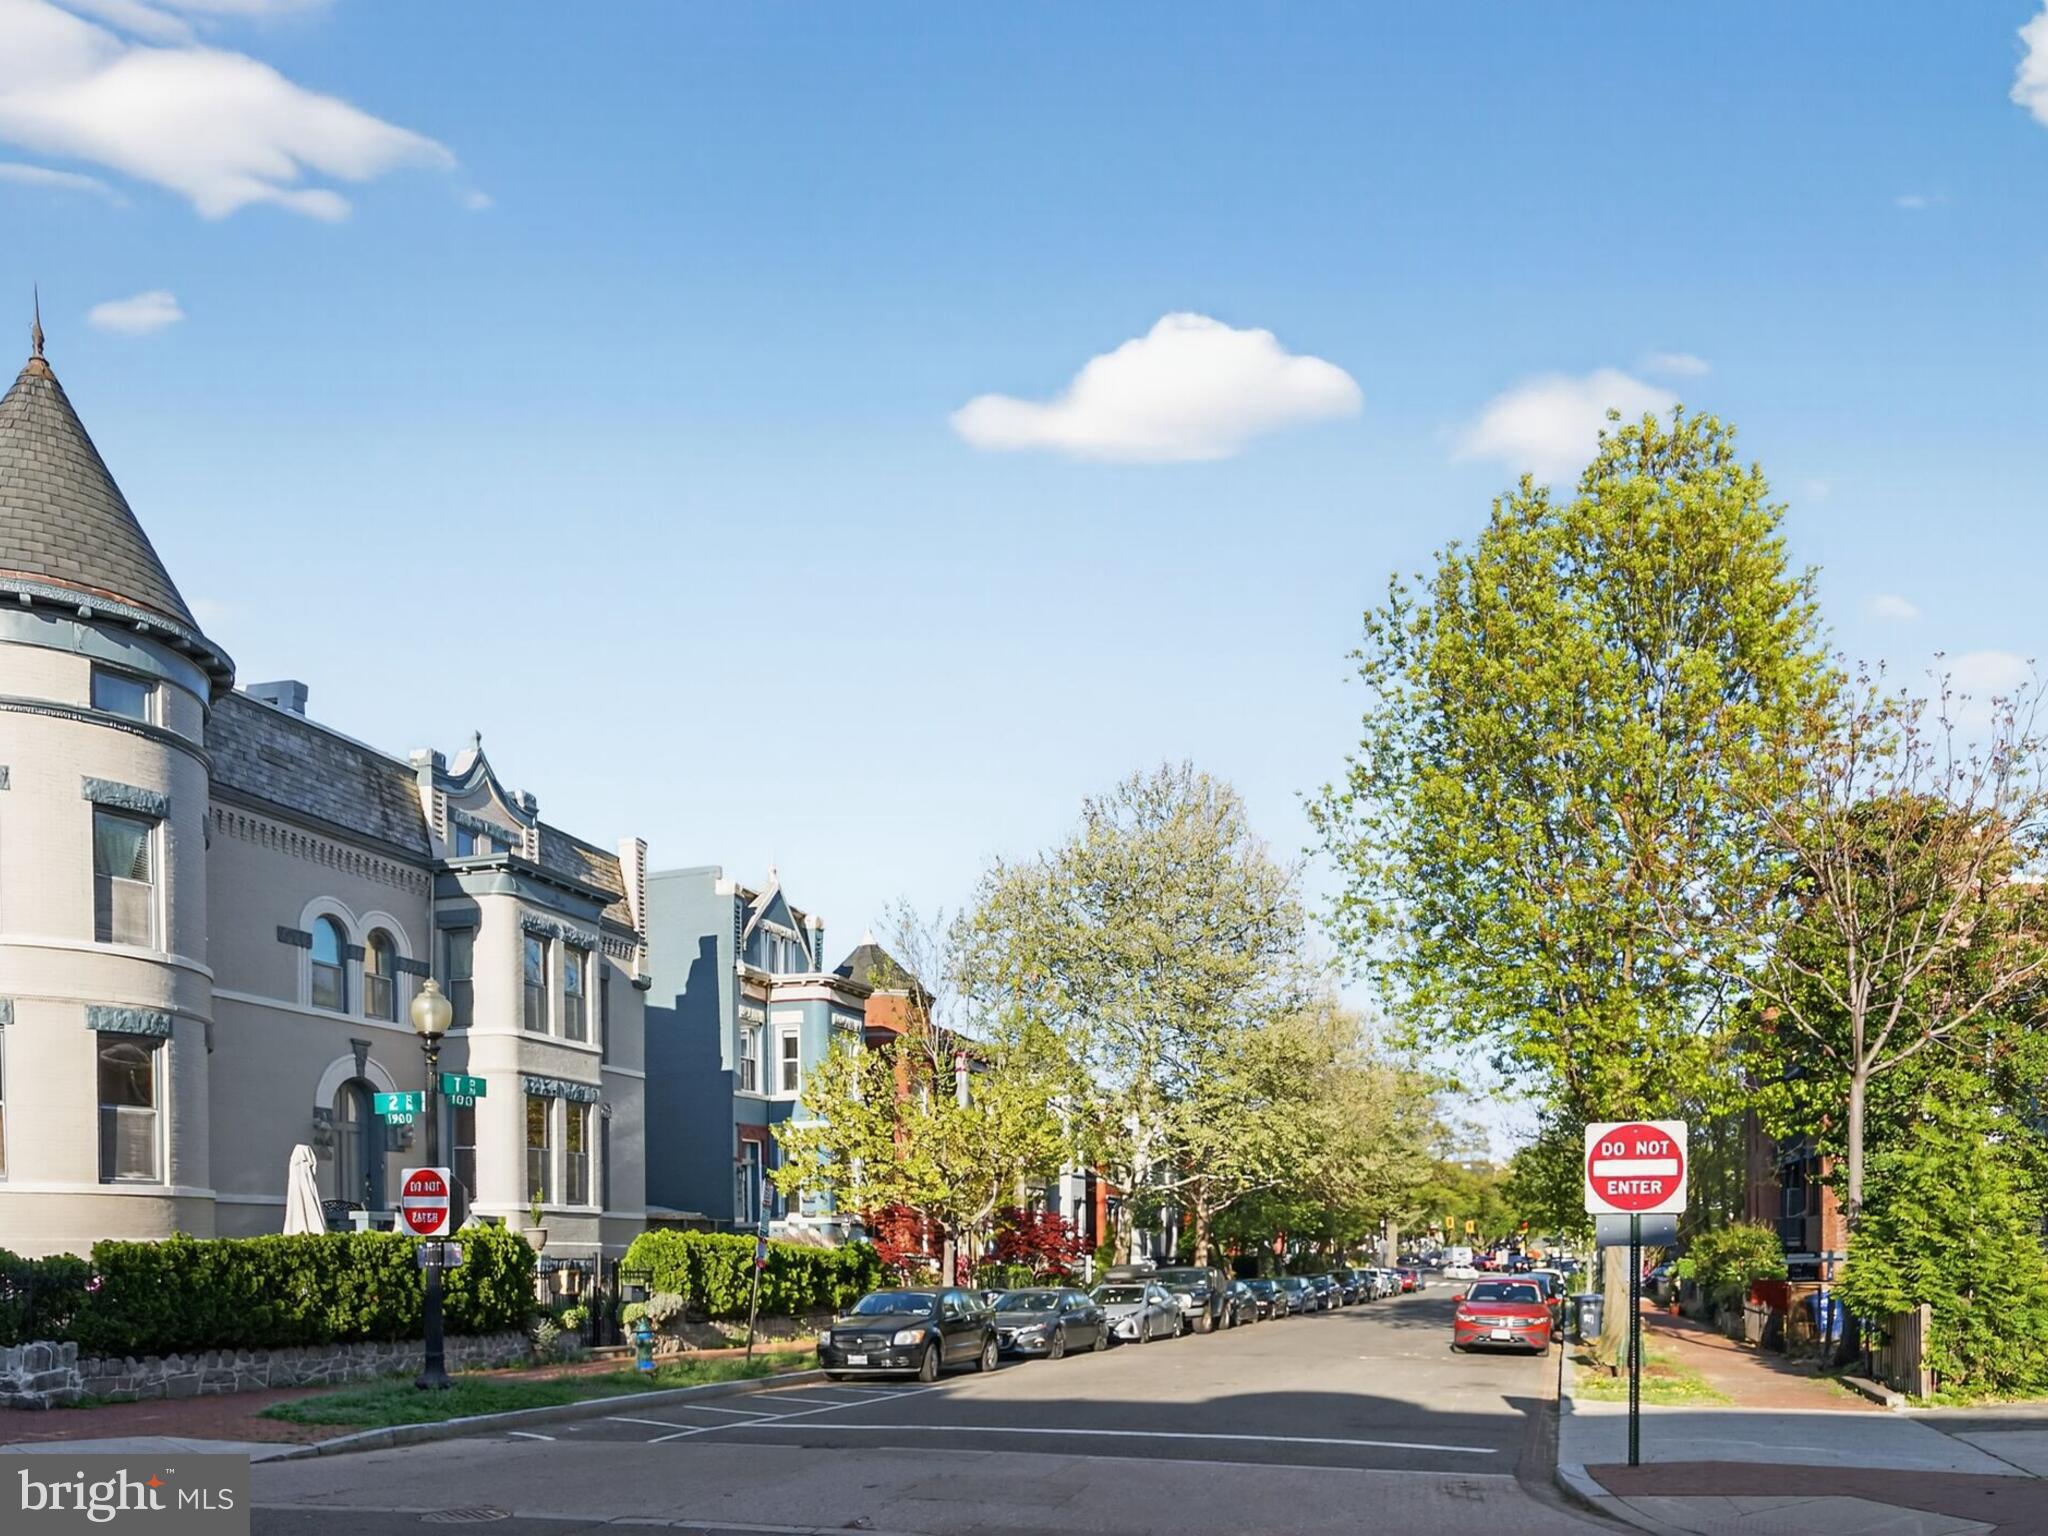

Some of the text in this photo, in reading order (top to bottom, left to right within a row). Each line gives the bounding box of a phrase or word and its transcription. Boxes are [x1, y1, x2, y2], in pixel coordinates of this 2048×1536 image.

[454, 1077, 461, 1092] T
[388, 1095, 399, 1111] 2
[452, 1094, 473, 1106] 100
[388, 1113, 413, 1124] 1900
[1601, 1140, 1670, 1156] DO NOT
[1607, 1180, 1662, 1195] ENTER
